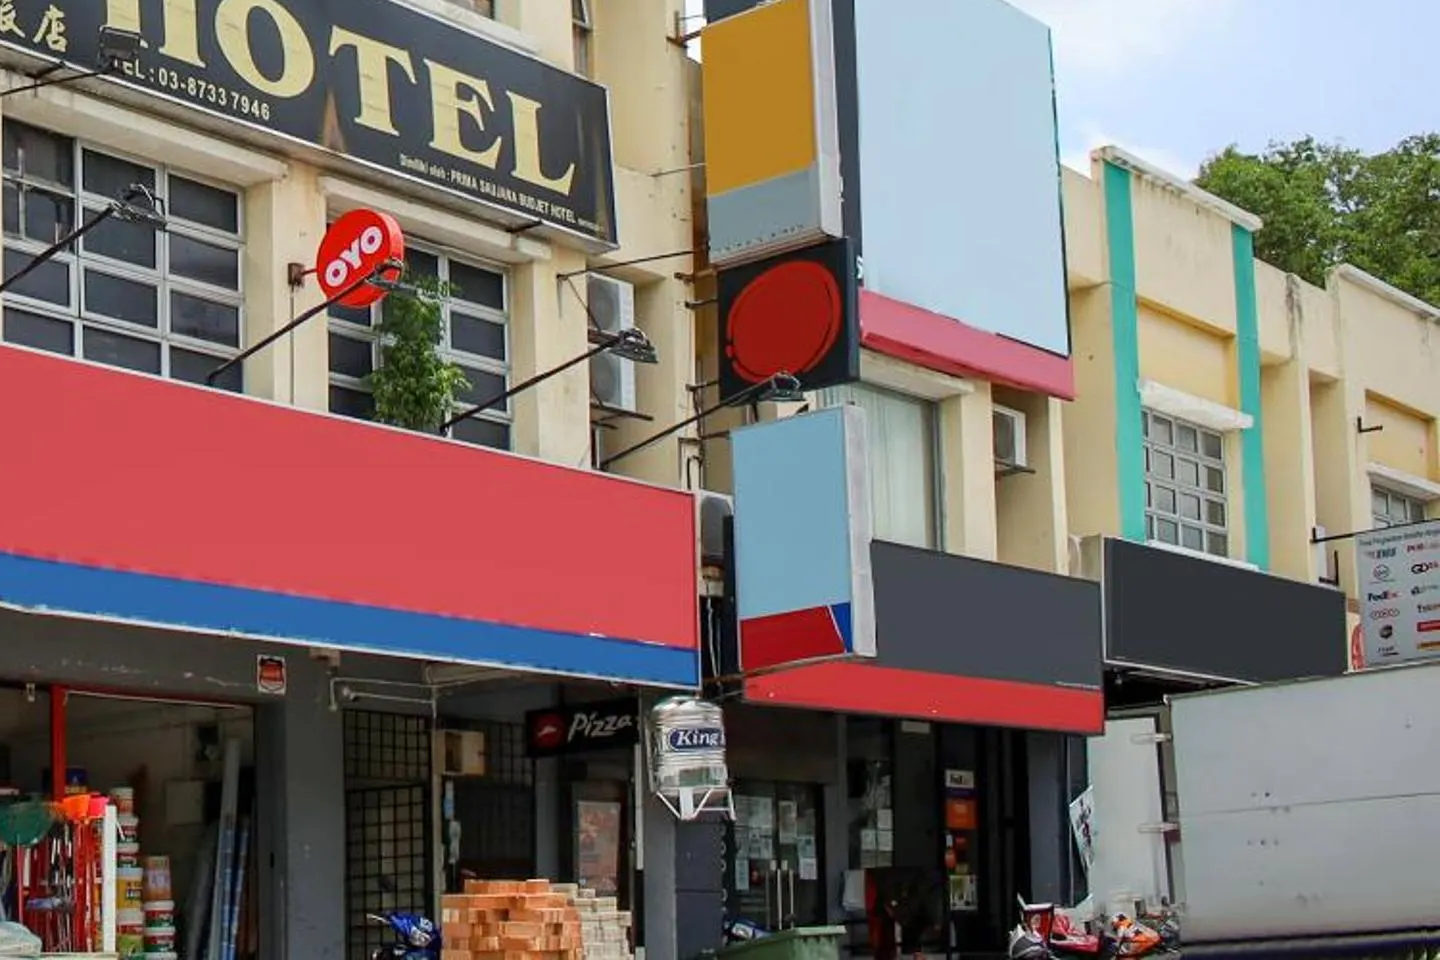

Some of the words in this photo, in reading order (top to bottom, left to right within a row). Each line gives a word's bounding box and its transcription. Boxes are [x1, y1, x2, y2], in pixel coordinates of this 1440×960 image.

[158, 68, 228, 106] 03-8733
[231, 92, 271, 120] 7946
[450, 169, 478, 191] PRIMA
[550, 203, 577, 224] HOTEL
[325, 226, 383, 287] OYO
[567, 711, 633, 743] Pizza
[676, 728, 719, 746] King
